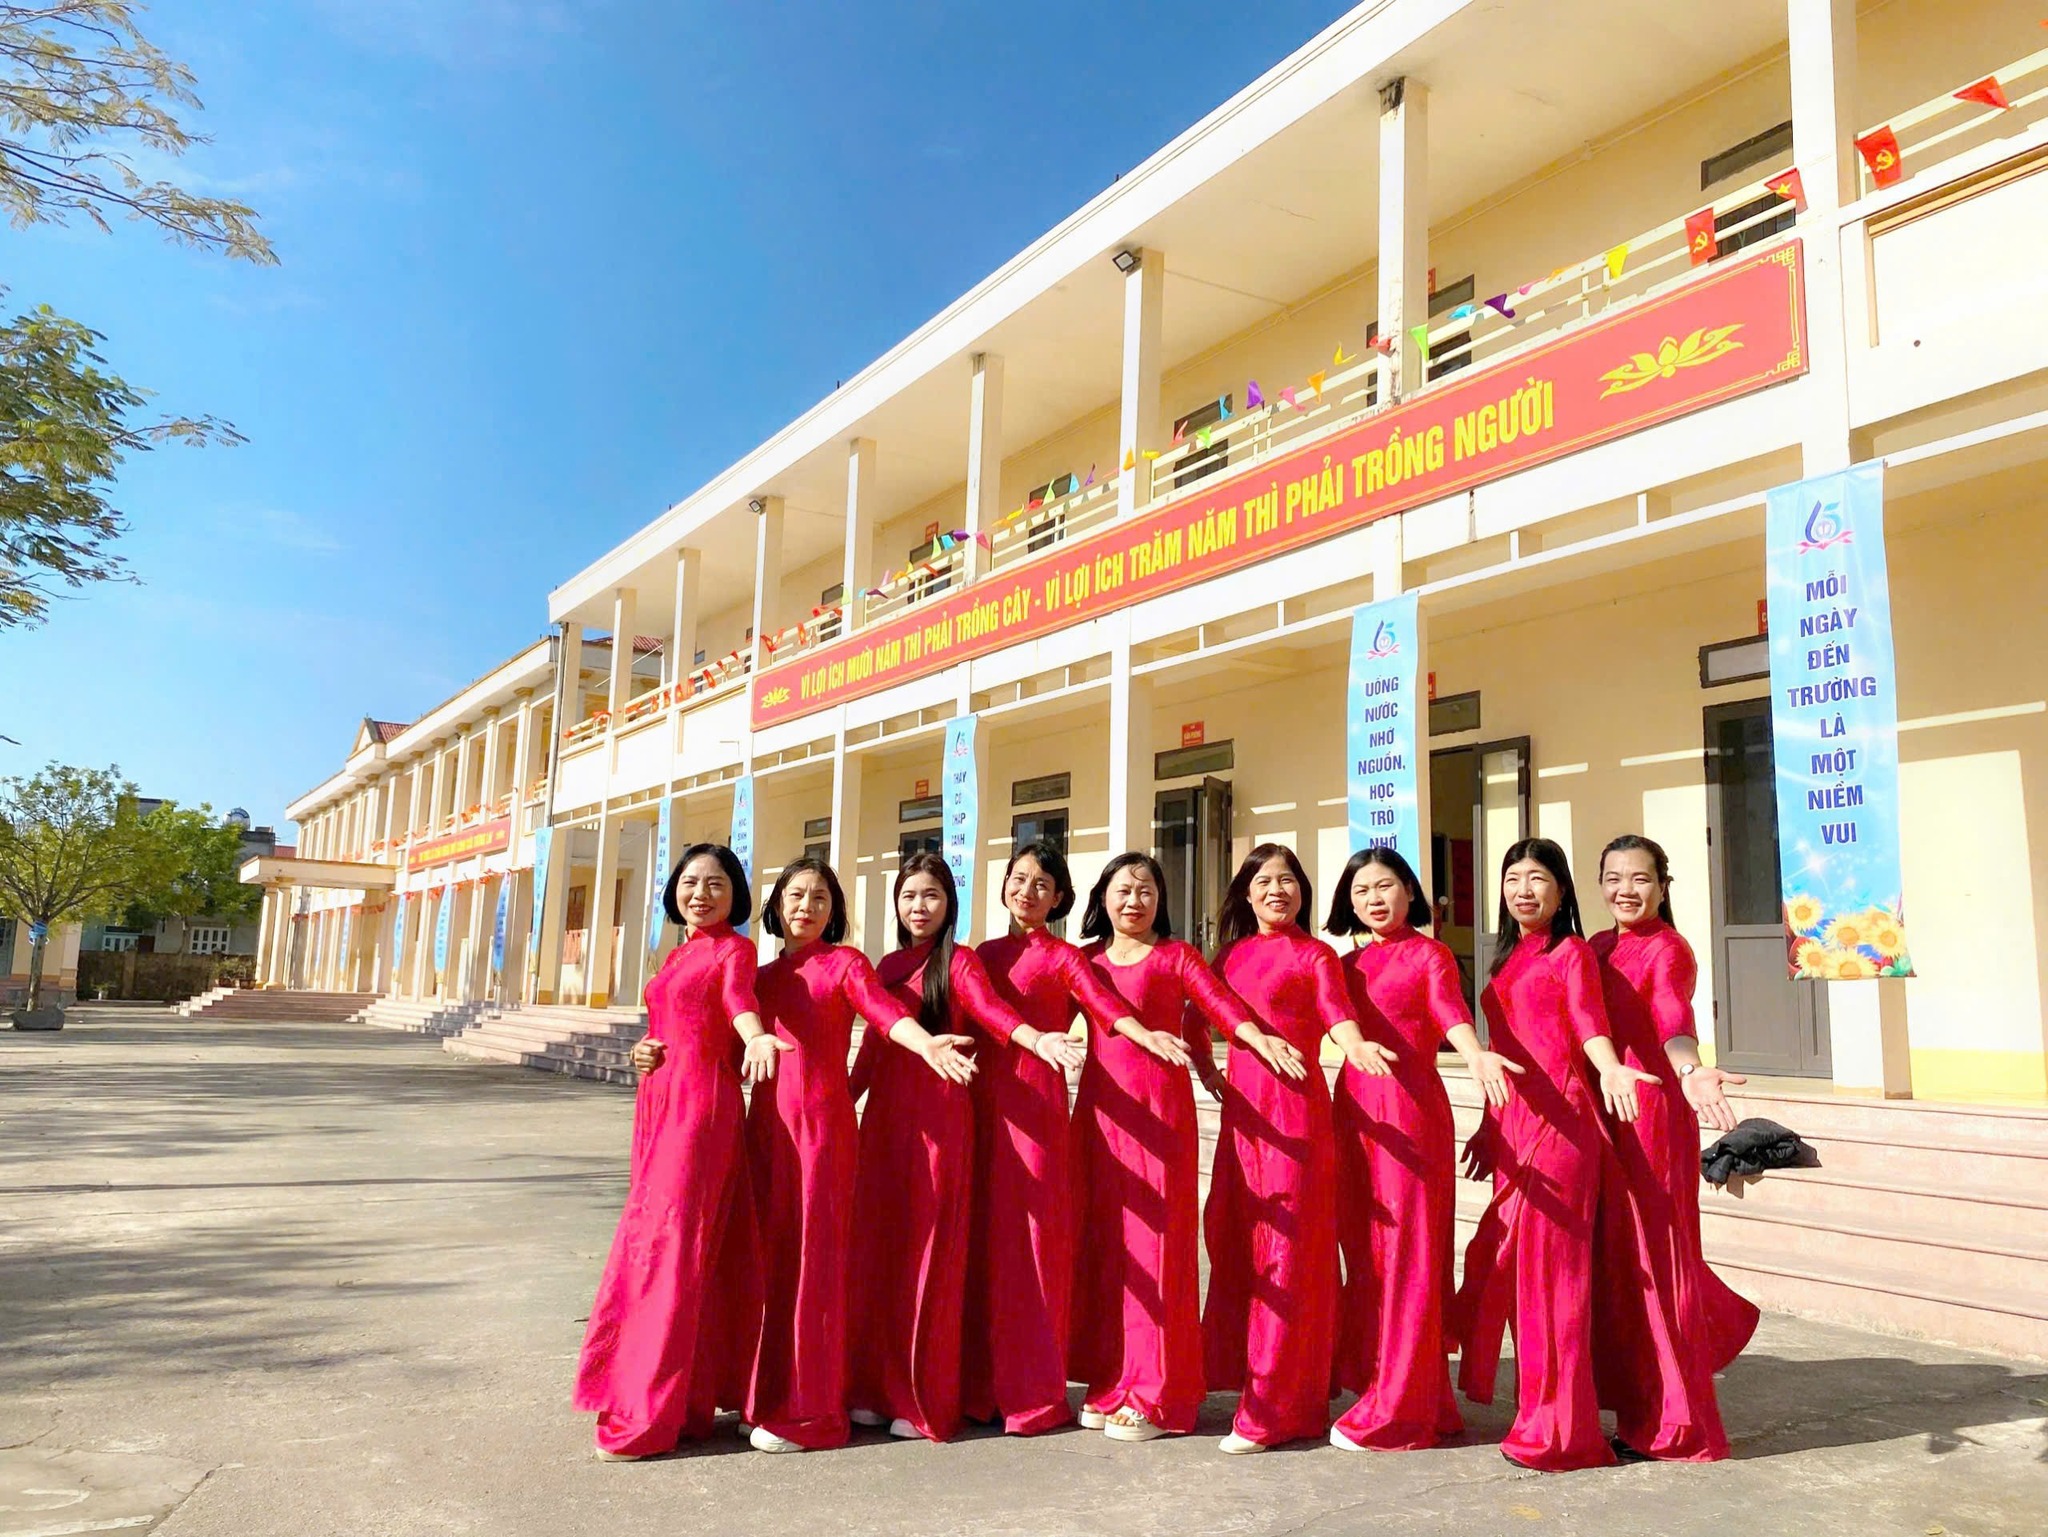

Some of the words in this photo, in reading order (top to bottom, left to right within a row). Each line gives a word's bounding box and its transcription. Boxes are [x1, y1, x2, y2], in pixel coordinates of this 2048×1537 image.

[801, 668, 811, 699] VÌ
[828, 660, 845, 691] ÍCH
[846, 645, 873, 685] MƯỜI
[875, 638, 901, 674] NĂM
[904, 625, 921, 663] THÌ
[924, 610, 952, 656] PHẢI
[1002, 585, 1031, 627] CÂY
[1045, 570, 1060, 612] VÌ
[1064, 562, 1090, 608] LỢI
[1095, 553, 1124, 595] ÍCH
[1129, 527, 1183, 582] TRĂM
[1188, 508, 1237, 561] NĂM
[1243, 481, 1279, 539] THÌ
[1285, 455, 1344, 524] PHẢI
[1352, 426, 1445, 498] TRỒNG
[1454, 376, 1554, 462] NGƯỜI
[1806, 570, 1847, 602] MỖI
[1800, 607, 1857, 638] NGÀY
[1807, 640, 1850, 670] ĐẾN
[1365, 674, 1399, 697] UỐNG
[1787, 676, 1877, 708] TRƯỜNG
[1365, 701, 1398, 723] NƯỚC
[1820, 712, 1846, 738] LÀ
[1369, 726, 1395, 748] NHỚ
[1811, 747, 1857, 776] MỘT
[1369, 782, 1394, 802] HỌC
[1807, 780, 1864, 810] NIỀM
[1370, 805, 1394, 826] TRÒ
[1821, 822, 1857, 845] VUI
